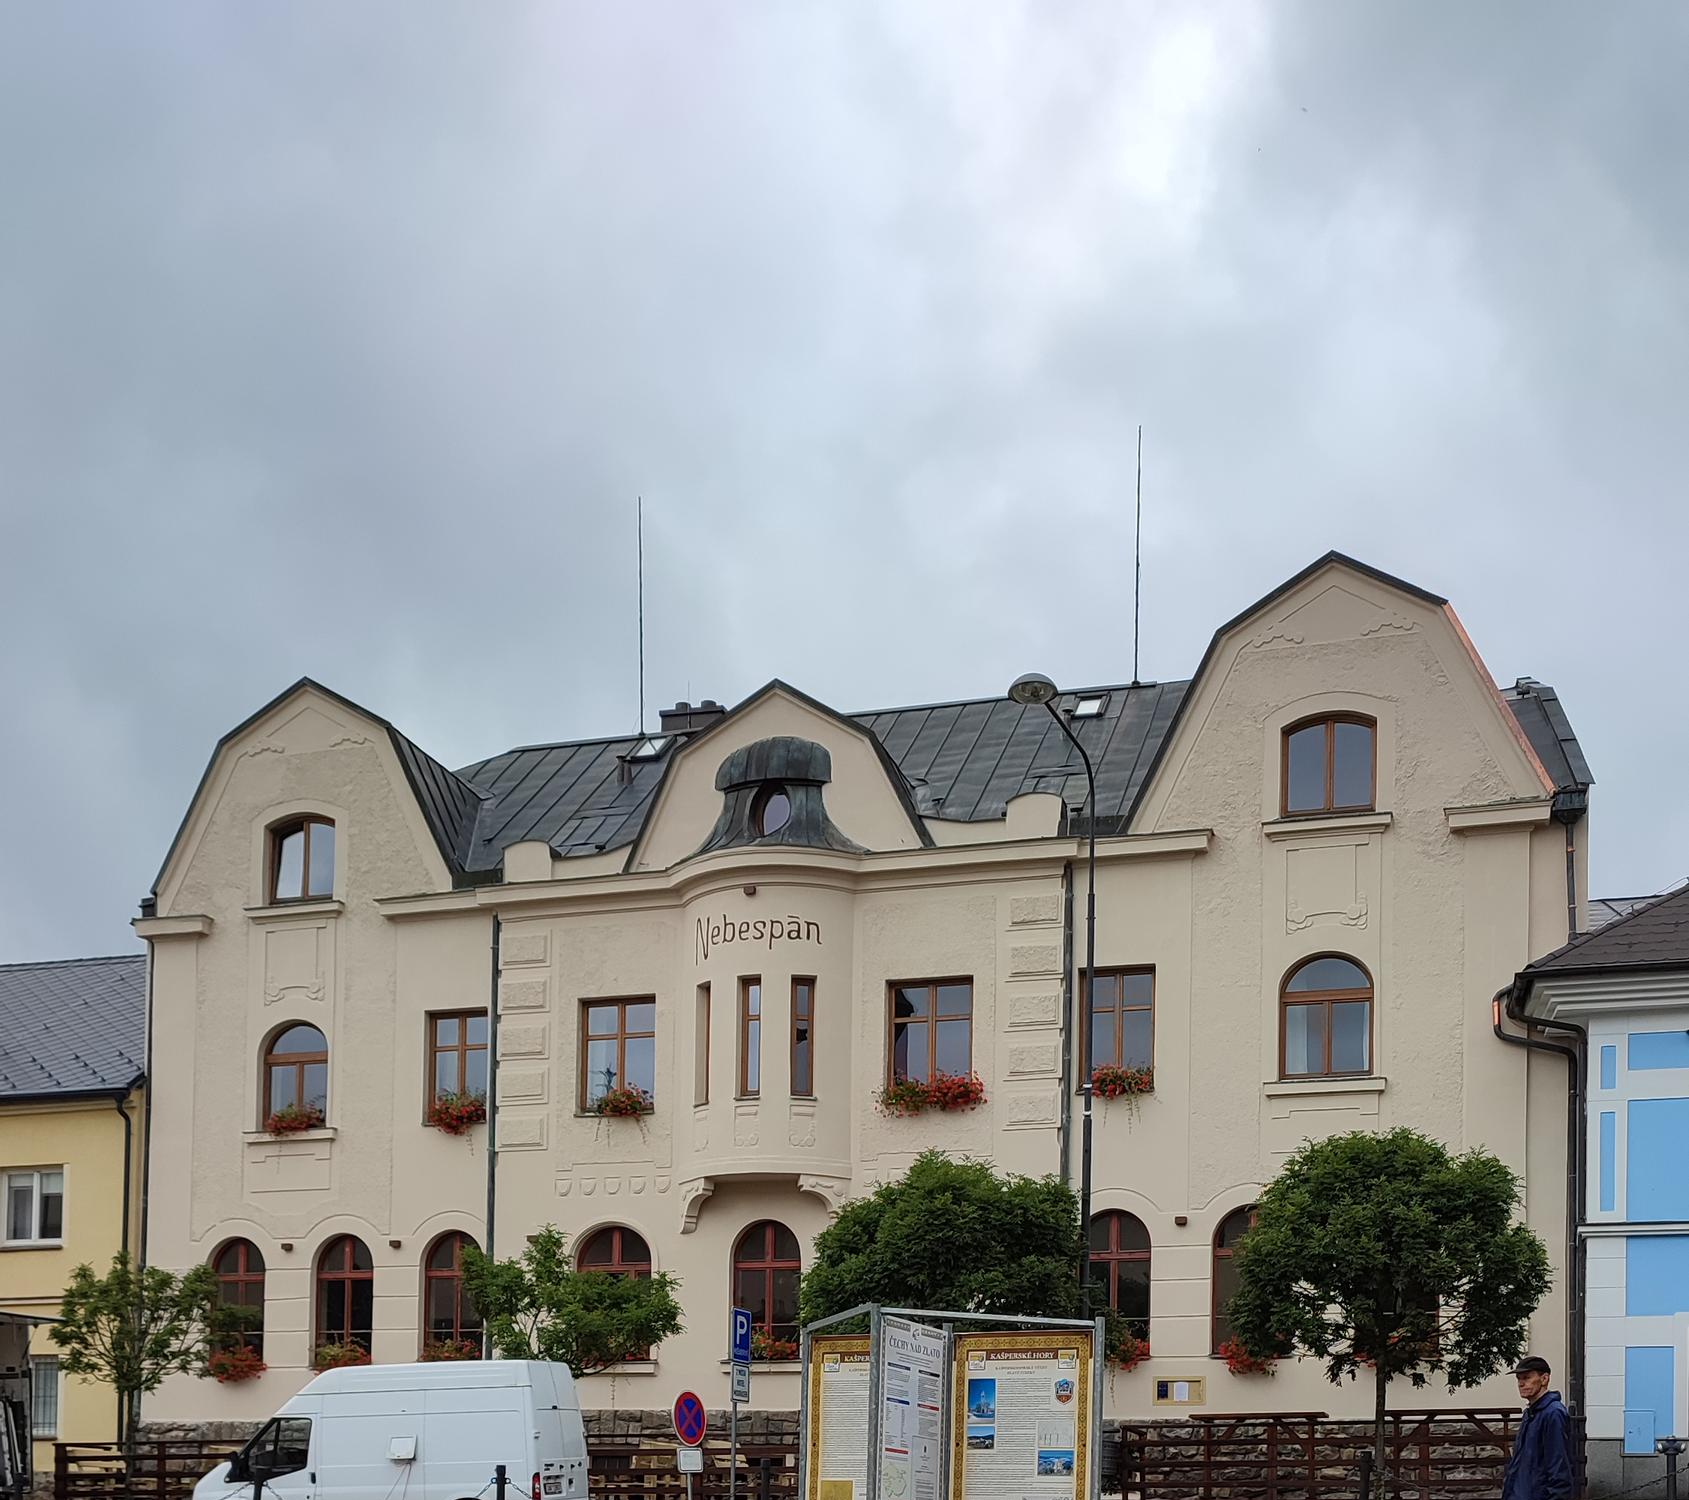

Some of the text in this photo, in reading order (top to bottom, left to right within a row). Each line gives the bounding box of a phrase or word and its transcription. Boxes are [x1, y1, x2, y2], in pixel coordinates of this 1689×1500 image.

[736, 1315, 748, 1345] P
[909, 1342, 922, 1354] NAD
[922, 1345, 941, 1359] ZLATO
[990, 1351, 1055, 1360] KAŠPERSKÉ HORY
[844, 1354, 870, 1362] KAŠPER
